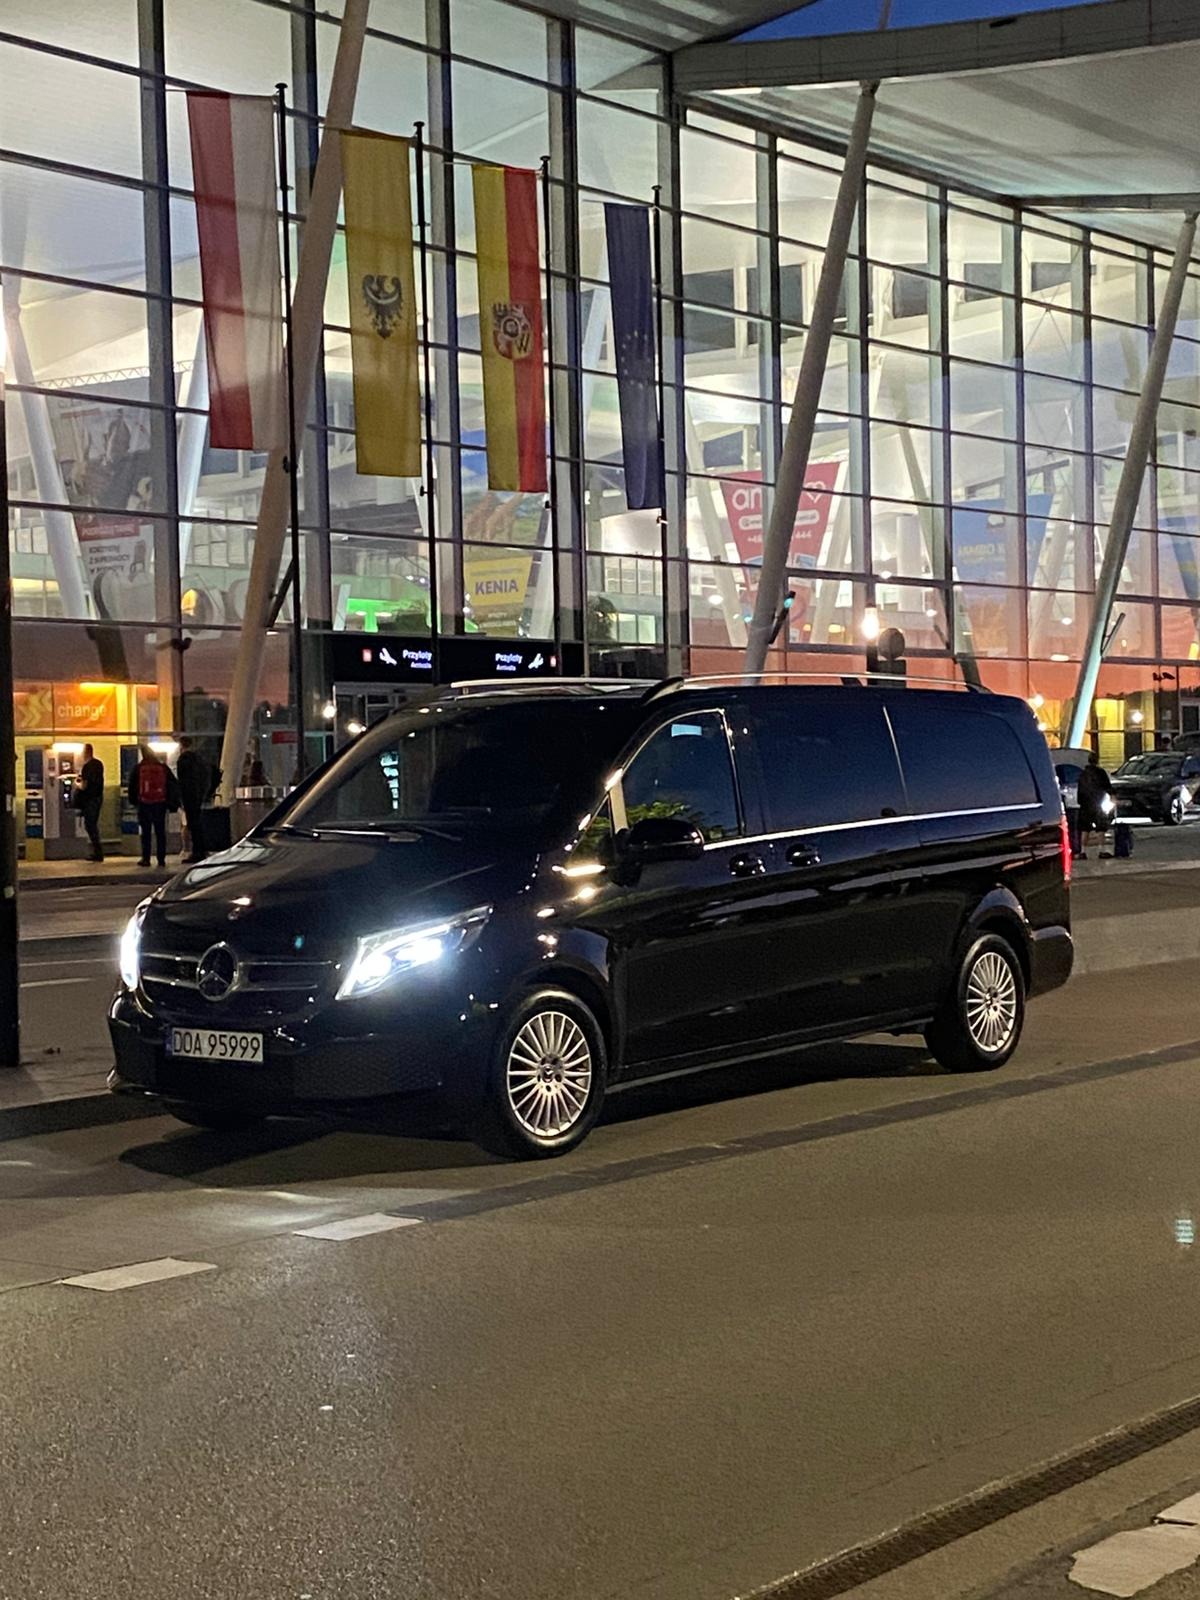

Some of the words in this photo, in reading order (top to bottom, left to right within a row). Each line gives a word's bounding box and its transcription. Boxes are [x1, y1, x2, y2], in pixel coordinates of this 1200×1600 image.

[475, 579, 519, 595] KENIA
[402, 649, 432, 661] Przyloty
[495, 652, 523, 664] Przyloty
[57, 701, 106, 721] change
[173, 1030, 202, 1054] DOA
[208, 1033, 261, 1059] 95999
